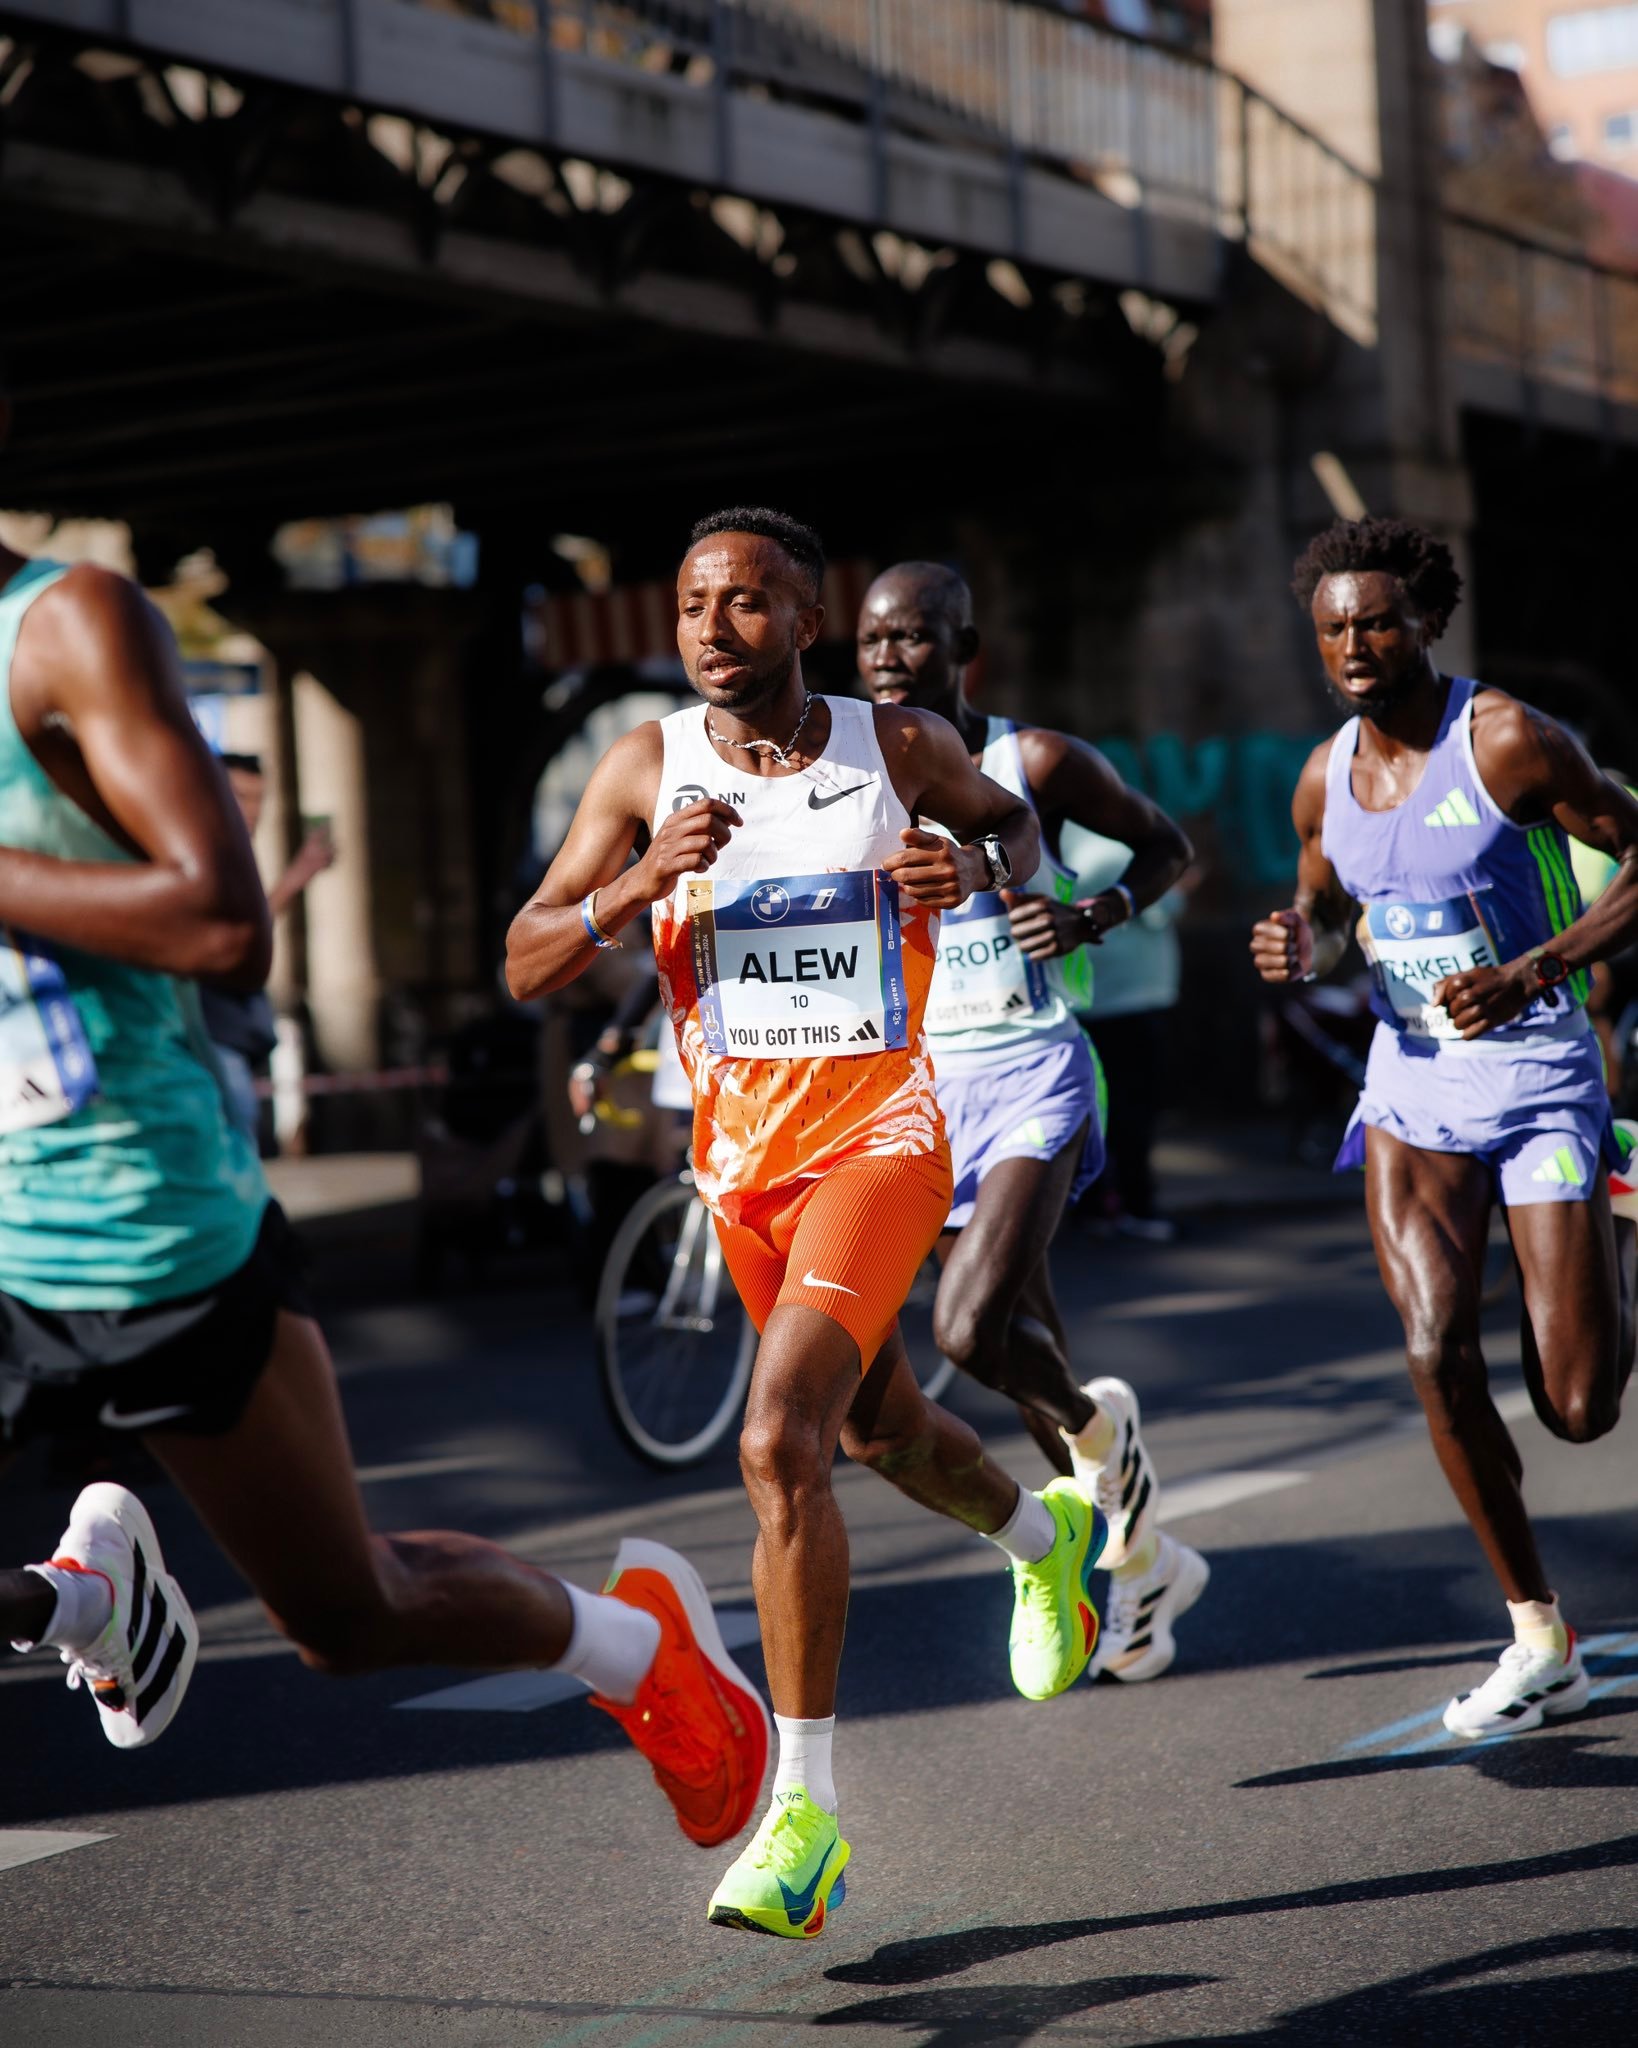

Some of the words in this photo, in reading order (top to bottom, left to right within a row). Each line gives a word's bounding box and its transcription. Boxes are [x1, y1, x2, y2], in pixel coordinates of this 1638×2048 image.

[755, 886, 784, 898] BMW
[703, 951, 713, 986] September
[738, 945, 859, 985] ALEW
[790, 994, 809, 1009] 10
[890, 977, 901, 1007] EVENTS
[728, 1027, 759, 1046] YOU
[765, 1026, 799, 1046] GOT
[801, 1024, 841, 1045] THIS
